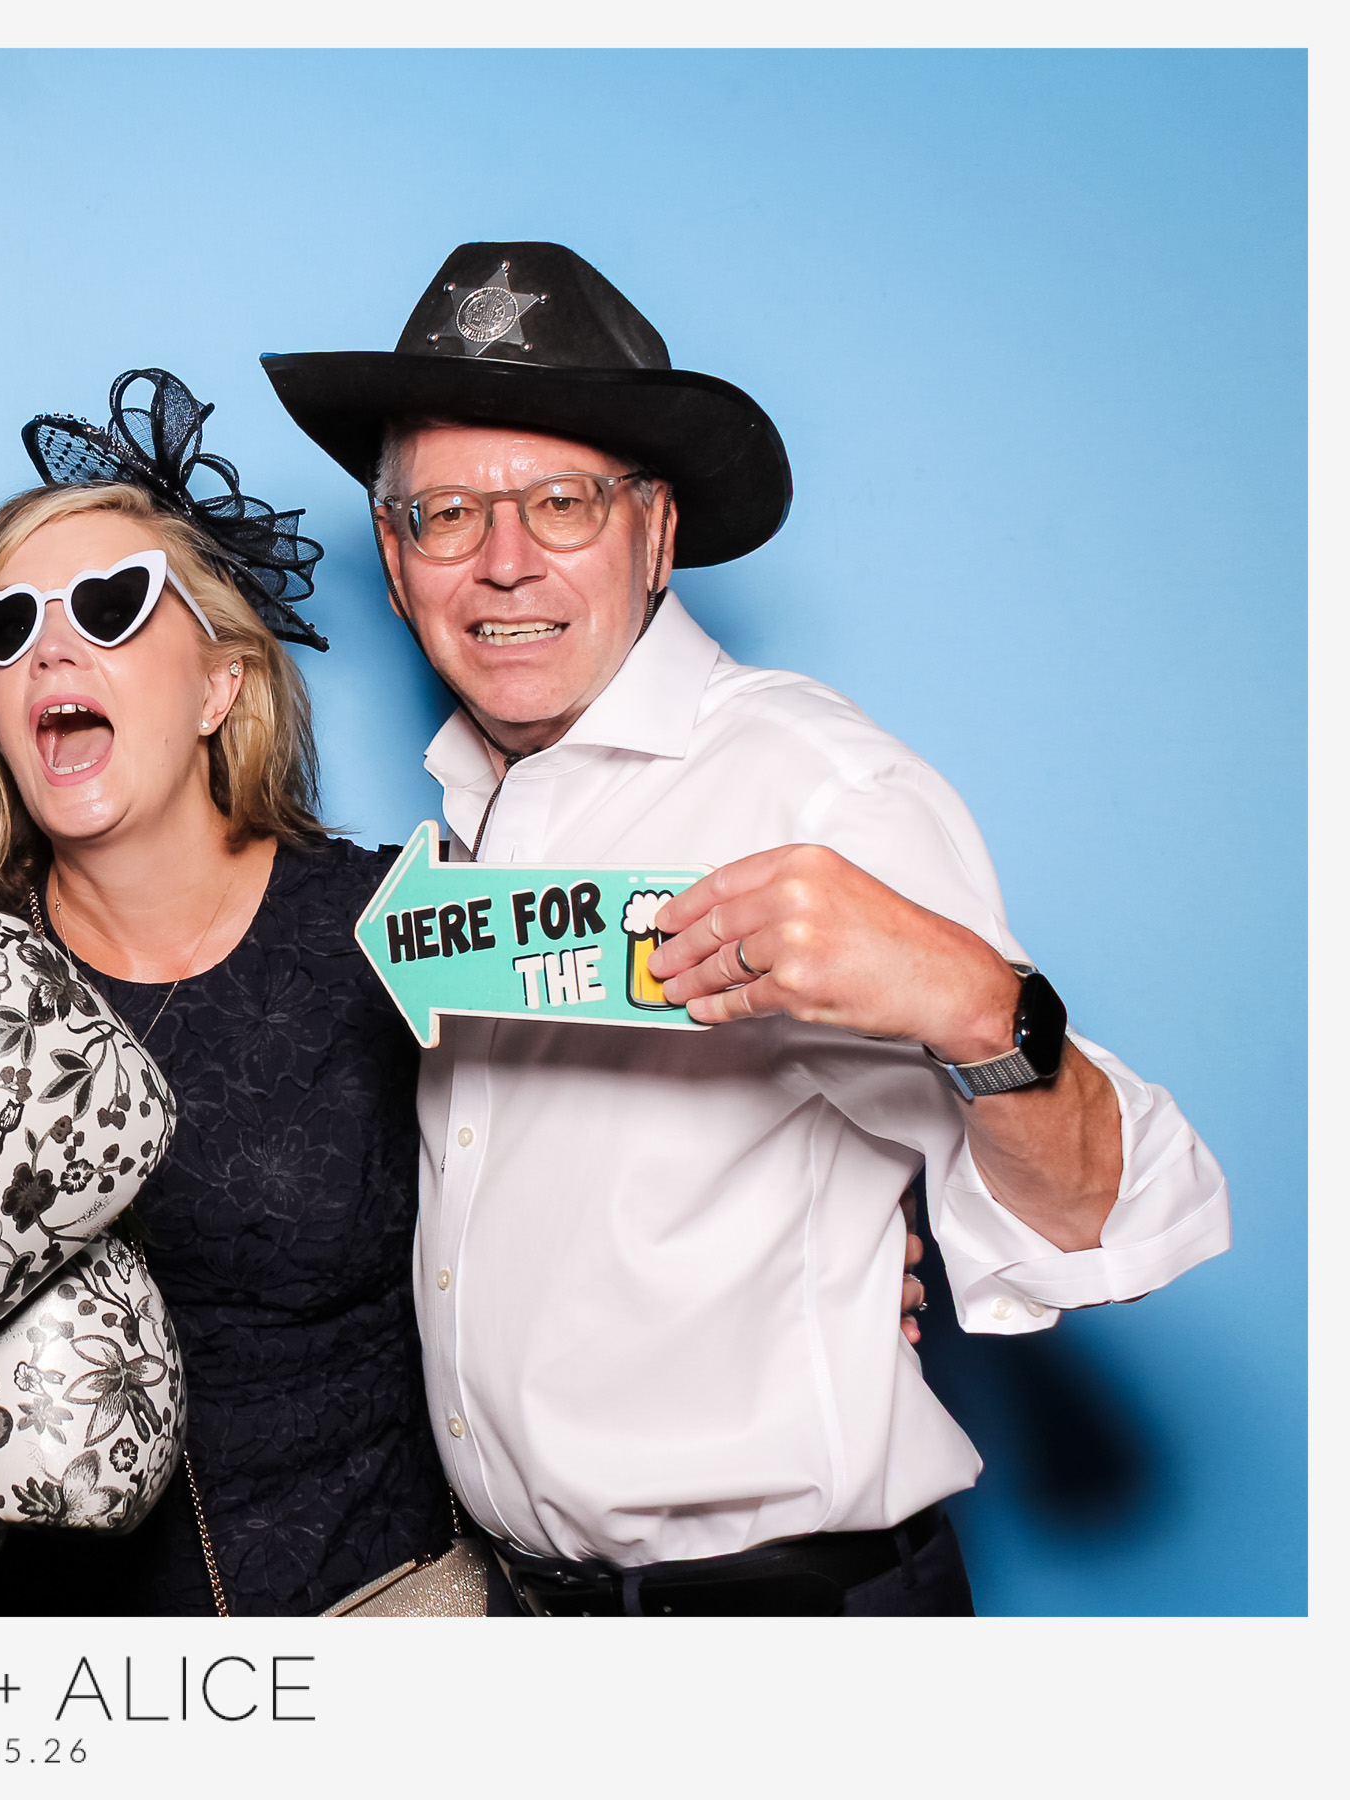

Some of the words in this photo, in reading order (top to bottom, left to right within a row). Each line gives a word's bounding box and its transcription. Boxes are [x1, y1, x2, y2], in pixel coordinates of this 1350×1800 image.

[383, 895, 497, 964] HERE
[510, 879, 607, 946] FOR
[512, 945, 607, 1010] THE
